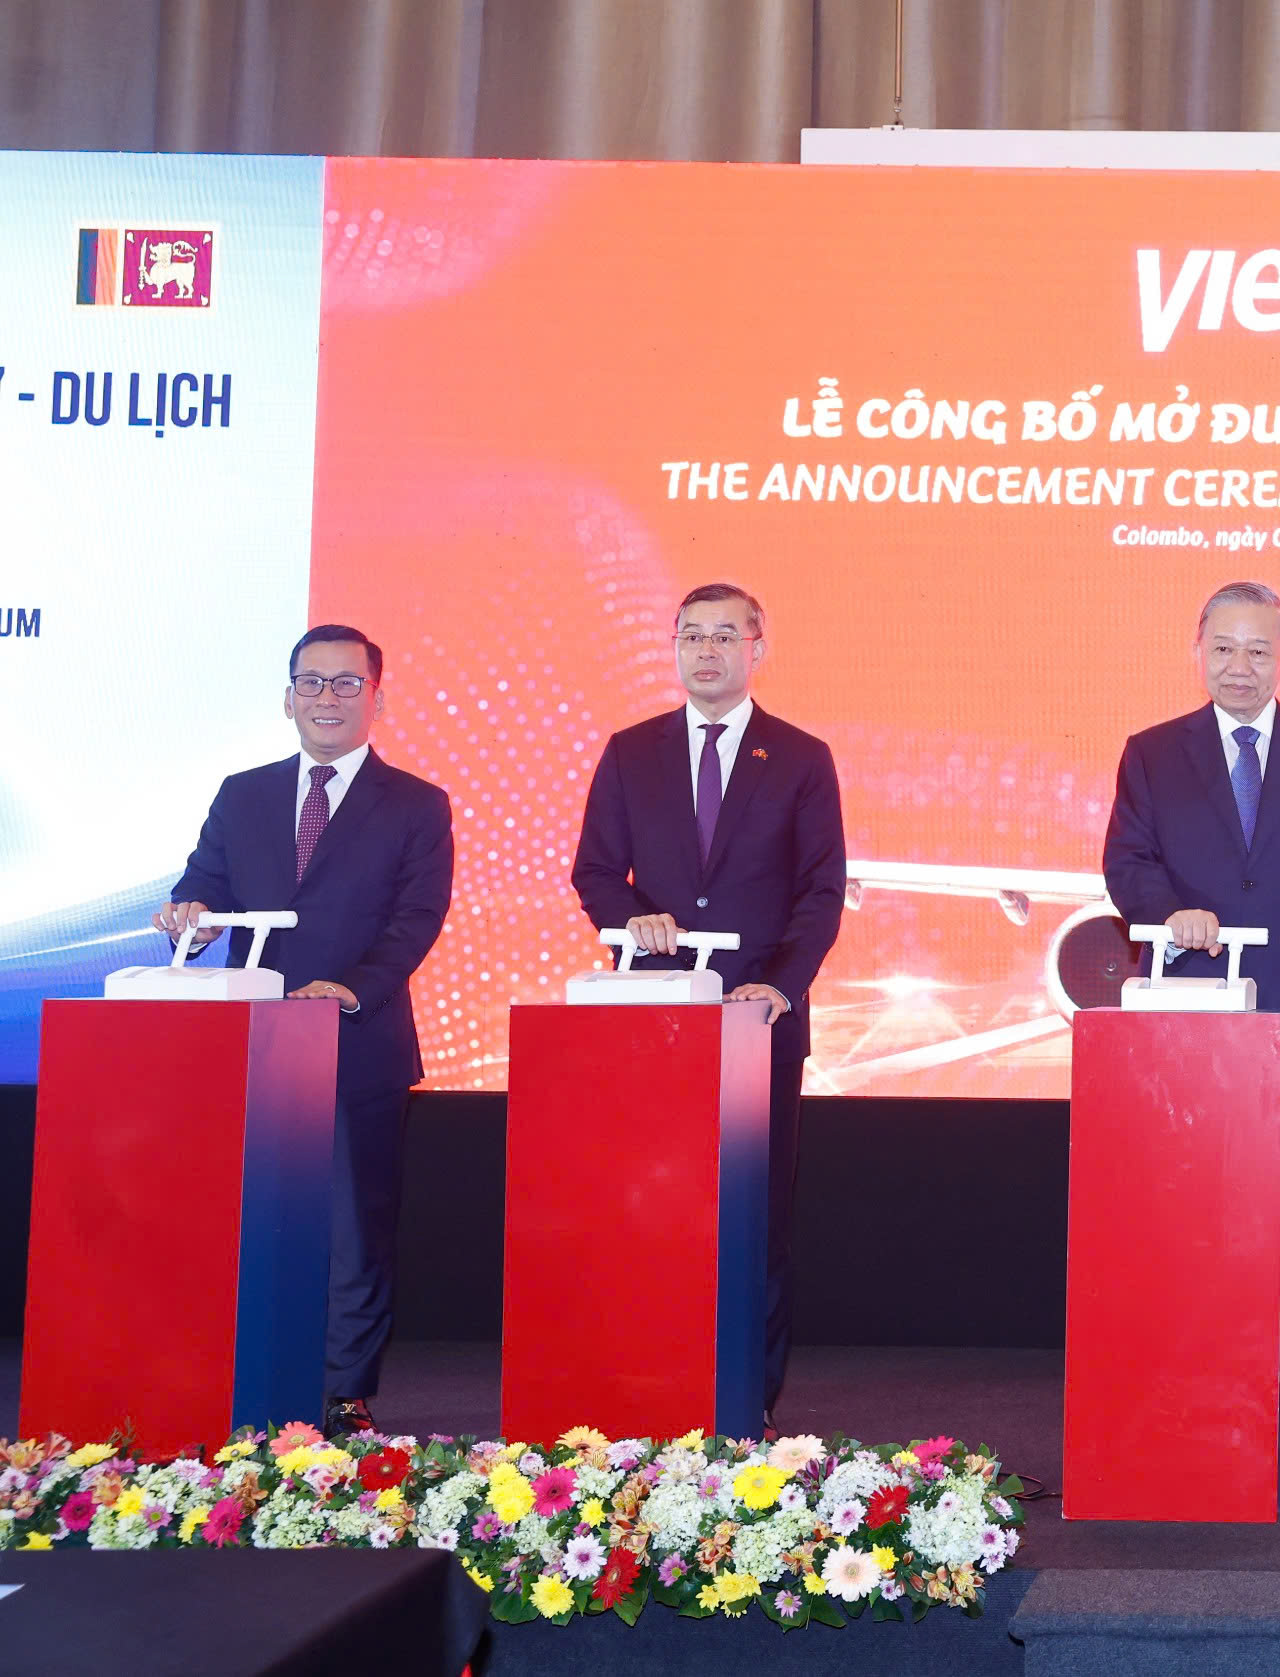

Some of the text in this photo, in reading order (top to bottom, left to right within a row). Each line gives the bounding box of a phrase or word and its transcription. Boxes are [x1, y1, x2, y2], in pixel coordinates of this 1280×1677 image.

[51, 371, 113, 426] DU
[128, 372, 232, 438] LỊCH
[782, 376, 844, 438] LỄ
[856, 388, 1008, 445] CÔNG
[1021, 383, 1105, 442] BỐ
[1109, 383, 1201, 443] MỞ
[661, 461, 749, 501] THE
[757, 462, 1156, 506] ANNOUNCEMENT
[1111, 523, 1211, 550] Colombo,
[1215, 524, 1269, 552] ngày
